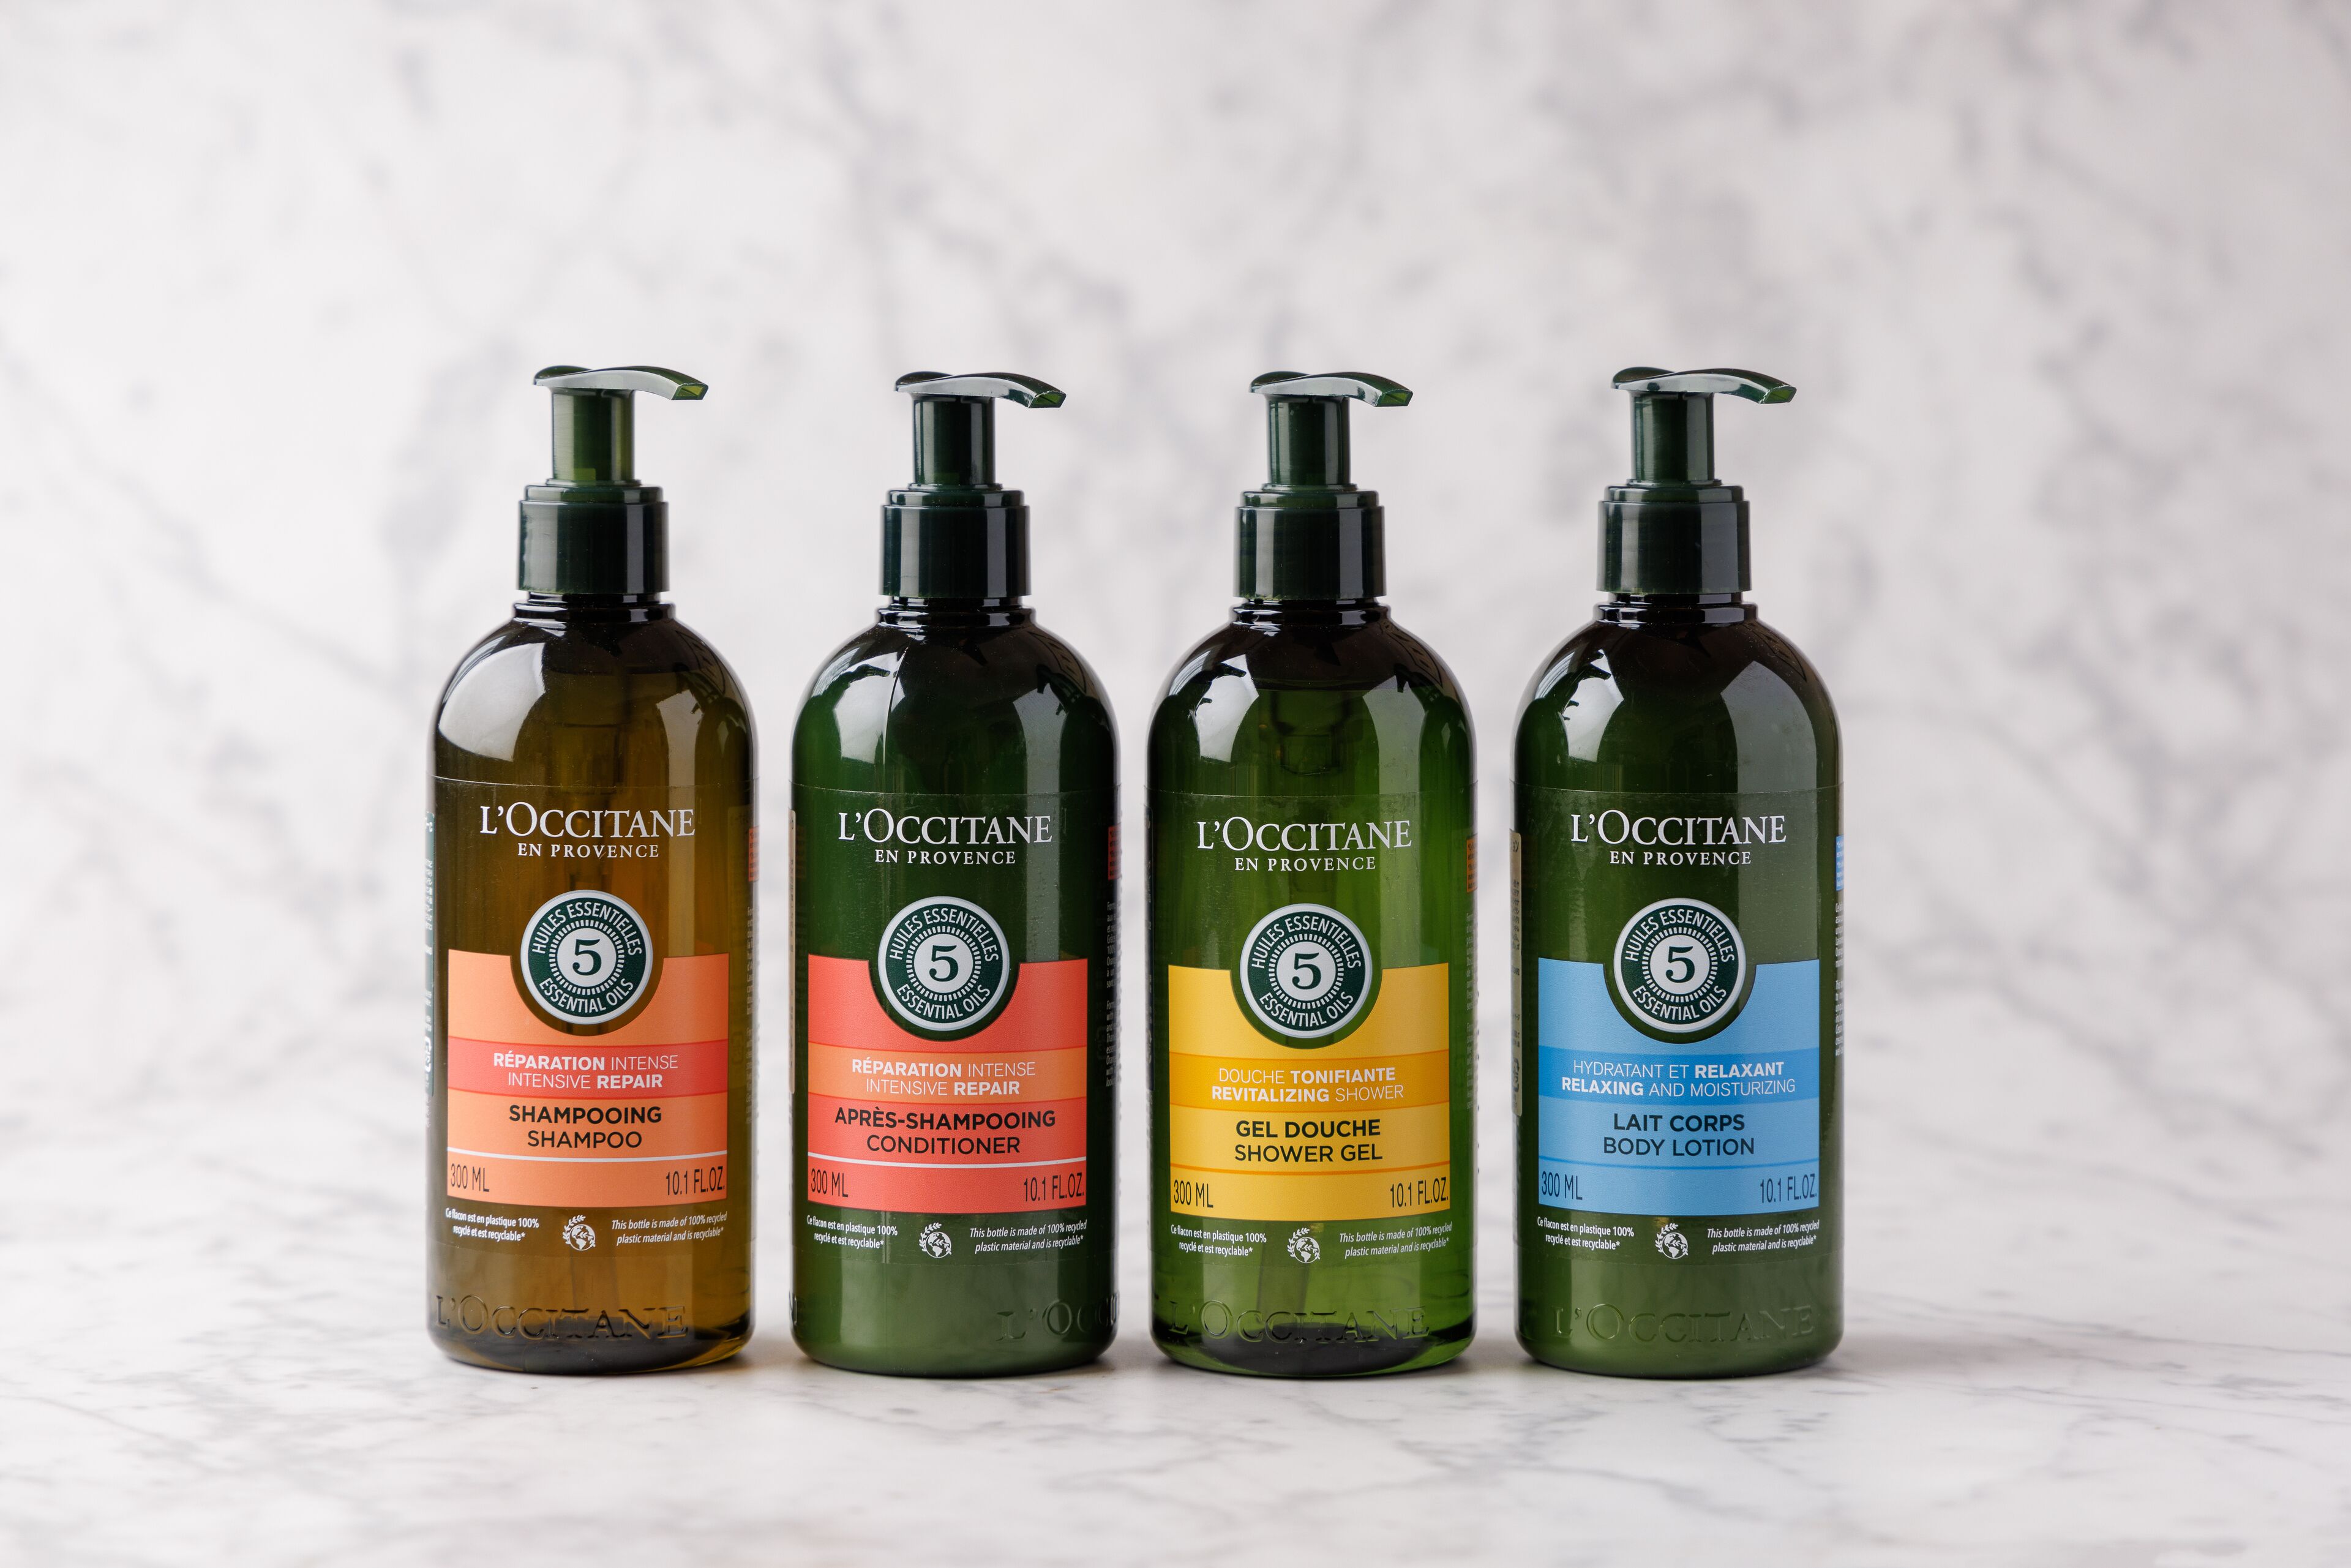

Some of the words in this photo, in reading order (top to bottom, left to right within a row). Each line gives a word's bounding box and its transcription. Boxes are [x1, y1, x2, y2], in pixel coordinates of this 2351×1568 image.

[479, 802, 695, 838] L'OCCITANE
[839, 808, 1052, 845] L'OCCITANE
[1571, 810, 1786, 846] L'OCCITANE
[1197, 816, 1412, 851] L'OCCITANE
[518, 843, 541, 857] EN
[551, 845, 659, 858] PROVENCE
[876, 850, 898, 863] EN
[907, 851, 1015, 865] PROVENCE
[1610, 851, 1633, 865] EN
[1644, 852, 1752, 865] PROVENCE
[1235, 858, 1258, 871] EN
[1268, 857, 1375, 871] PROVENCE
[531, 909, 566, 954] HUILES
[567, 902, 642, 955] ESSENTIELLES
[890, 916, 923, 960] HUILES
[923, 907, 999, 962] ESSENTIELLES
[1625, 917, 1659, 962] HUILES
[1659, 909, 1734, 962] ESSENTIELLES
[1251, 923, 1284, 969] HUILES
[1284, 915, 1361, 969] ESSENTIELLES
[572, 939, 601, 975] 5
[929, 945, 958, 981] 5
[1666, 946, 1694, 983] 5
[1292, 953, 1321, 990] 5
[539, 978, 606, 1013] ESSENTIAL
[607, 978, 634, 1005] OILS
[896, 984, 963, 1019] ESSENTIAL
[964, 985, 991, 1012] OILS
[1632, 986, 1700, 1020] ESSENTIAL
[1701, 986, 1727, 1013] OILS
[1259, 992, 1326, 1027] ESSENTIAL
[1327, 992, 1354, 1019] OILS
[494, 1051, 605, 1071] RÉPARATION
[611, 1055, 678, 1070] INTENSE
[852, 1057, 962, 1077] RÉPARATION
[968, 1062, 1036, 1076] INTENSE
[1573, 1060, 1663, 1078] HYDRATANT
[1670, 1065, 1689, 1078] ET
[1695, 1062, 1783, 1078] RELAXANT
[508, 1072, 591, 1089] INTENSIVE
[597, 1075, 662, 1089] REPAIR
[1219, 1068, 1284, 1085] DOUCHE
[1291, 1067, 1395, 1084] TONIFIANTE
[866, 1079, 947, 1095] INTENSIVE
[954, 1081, 1019, 1095] REPAIR
[1212, 1086, 1329, 1103] REVITALIZING
[1336, 1085, 1404, 1101] SHOWER
[1562, 1078, 1643, 1096] RELAXING
[1649, 1082, 1684, 1096] AND
[1691, 1079, 1795, 1097] MOISTURIZING
[509, 1105, 661, 1123] SHAMPOOING
[834, 1107, 1056, 1130] APRÈS-SHAMPOOING
[1614, 1113, 1662, 1131] LAIT
[1670, 1114, 1745, 1131] CORPS
[1236, 1120, 1278, 1138] GEL
[1286, 1119, 1381, 1138] DOUCHE
[528, 1131, 642, 1149] SHAMPOO
[867, 1135, 1020, 1154] CONDITIONER
[1603, 1138, 1664, 1155] BODY
[1673, 1138, 1755, 1156] LOTION
[1235, 1144, 1333, 1163] SHOWER
[1341, 1144, 1382, 1161] GEL
[451, 1164, 468, 1188] 300
[472, 1166, 490, 1192] ML
[666, 1171, 688, 1195] 10.1
[811, 1169, 828, 1192] 300
[831, 1172, 848, 1198] ML
[1542, 1171, 1560, 1196] 300
[1564, 1175, 1583, 1201] ML
[1024, 1177, 1046, 1201] 10.1
[1174, 1179, 1191, 1205] 300
[1196, 1182, 1213, 1208] ML
[1390, 1184, 1412, 1208] 10.1
[1760, 1178, 1783, 1203] 10.1
[612, 1220, 626, 1229] This
[628, 1219, 650, 1229] bottle
[651, 1220, 657, 1228] is
[659, 1217, 678, 1228] made
[680, 1216, 688, 1226] of
[689, 1215, 705, 1225] 100%
[707, 1211, 727, 1225] recycled
[970, 1228, 984, 1237] This
[986, 1228, 1008, 1237] bottle
[1010, 1228, 1016, 1236] is
[1018, 1226, 1037, 1236] made
[1039, 1224, 1046, 1234] of
[1048, 1223, 1064, 1233] 100%
[1065, 1220, 1087, 1233] recycled
[1537, 1217, 1543, 1226] Ce
[1544, 1217, 1559, 1229] flacon
[1580, 1224, 1610, 1237] plastique
[1613, 1226, 1634, 1237] 100%
[1708, 1228, 1722, 1238] This
[1723, 1228, 1745, 1237] bottle
[1747, 1228, 1752, 1236] is
[1753, 1226, 1772, 1236] made
[1774, 1225, 1781, 1234] of
[1783, 1223, 1799, 1234] 100%
[1800, 1220, 1820, 1234] recycled
[617, 1234, 641, 1246] plastic
[643, 1232, 672, 1242] material
[673, 1231, 686, 1240] and
[688, 1231, 692, 1239] is
[1171, 1225, 1176, 1234] Ce
[1178, 1225, 1192, 1237] flacon
[1212, 1231, 1243, 1244] plastique
[1245, 1233, 1267, 1242] 100%
[1340, 1233, 1354, 1242] This
[1356, 1232, 1377, 1242] bottle
[1379, 1231, 1384, 1240] is
[1386, 1229, 1405, 1239] made
[1407, 1228, 1414, 1237] of
[1415, 1226, 1431, 1236] 100%
[1433, 1221, 1452, 1236] recycled
[1545, 1234, 1563, 1245] recyclé
[975, 1242, 999, 1254] plastic
[1001, 1240, 1030, 1251] material
[1032, 1239, 1044, 1249] and
[1046, 1239, 1051, 1248] is
[1179, 1242, 1196, 1253] recyclé
[1345, 1247, 1368, 1259] plastic
[1371, 1244, 1399, 1255] material
[1401, 1242, 1412, 1253] and
[1414, 1242, 1419, 1251] is
[1712, 1242, 1736, 1255] plastic
[1738, 1240, 1766, 1251] material
[1768, 1239, 1780, 1249] and
[1782, 1239, 1786, 1248] is
